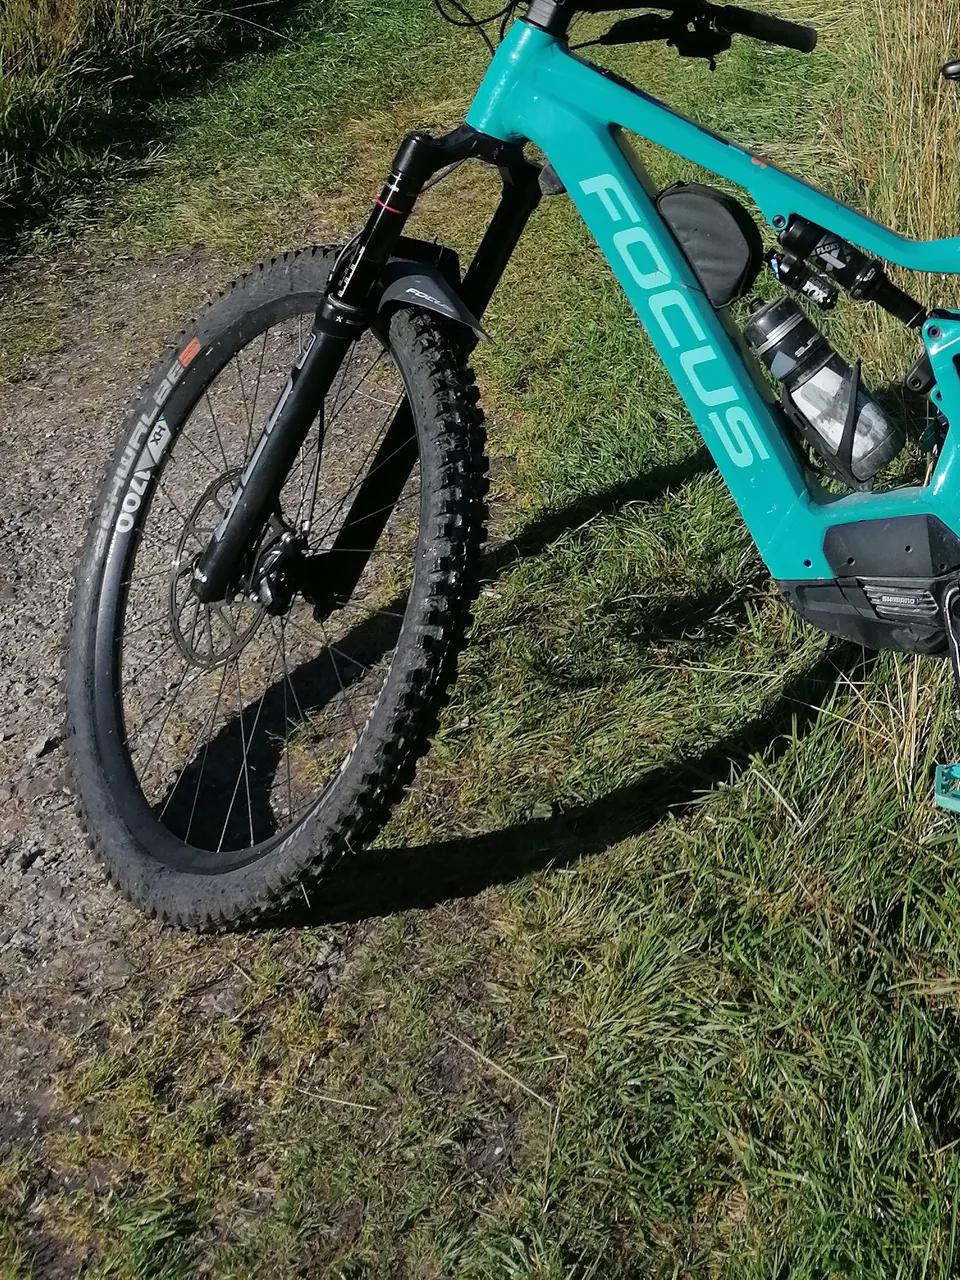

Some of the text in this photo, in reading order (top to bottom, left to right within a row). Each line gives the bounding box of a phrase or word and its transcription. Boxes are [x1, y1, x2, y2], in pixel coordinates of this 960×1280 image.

[579, 173, 770, 468] FOCUS
[802, 280, 828, 303] FOX
[115, 469, 151, 533] 1700
